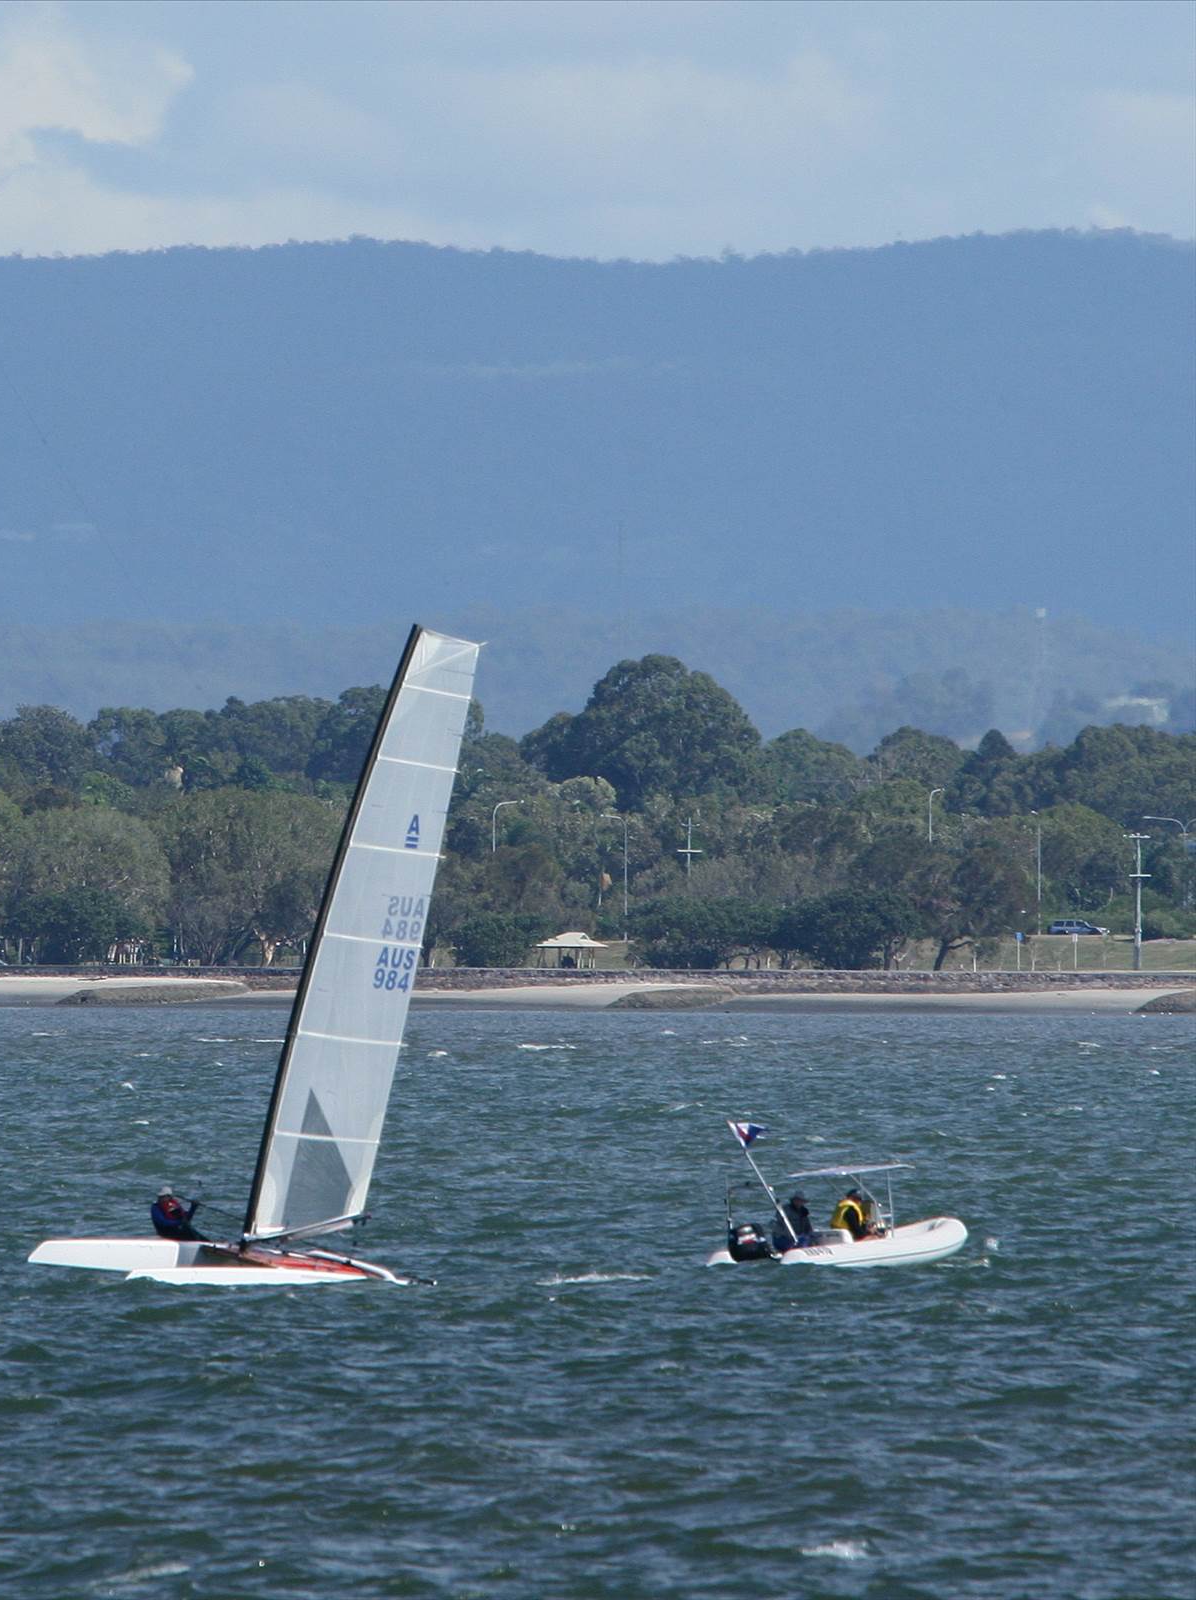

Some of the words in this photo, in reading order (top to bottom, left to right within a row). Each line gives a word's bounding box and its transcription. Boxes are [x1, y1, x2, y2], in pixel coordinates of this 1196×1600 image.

[407, 815, 420, 835] A
[376, 947, 415, 970] AUS
[372, 968, 409, 992] 984
